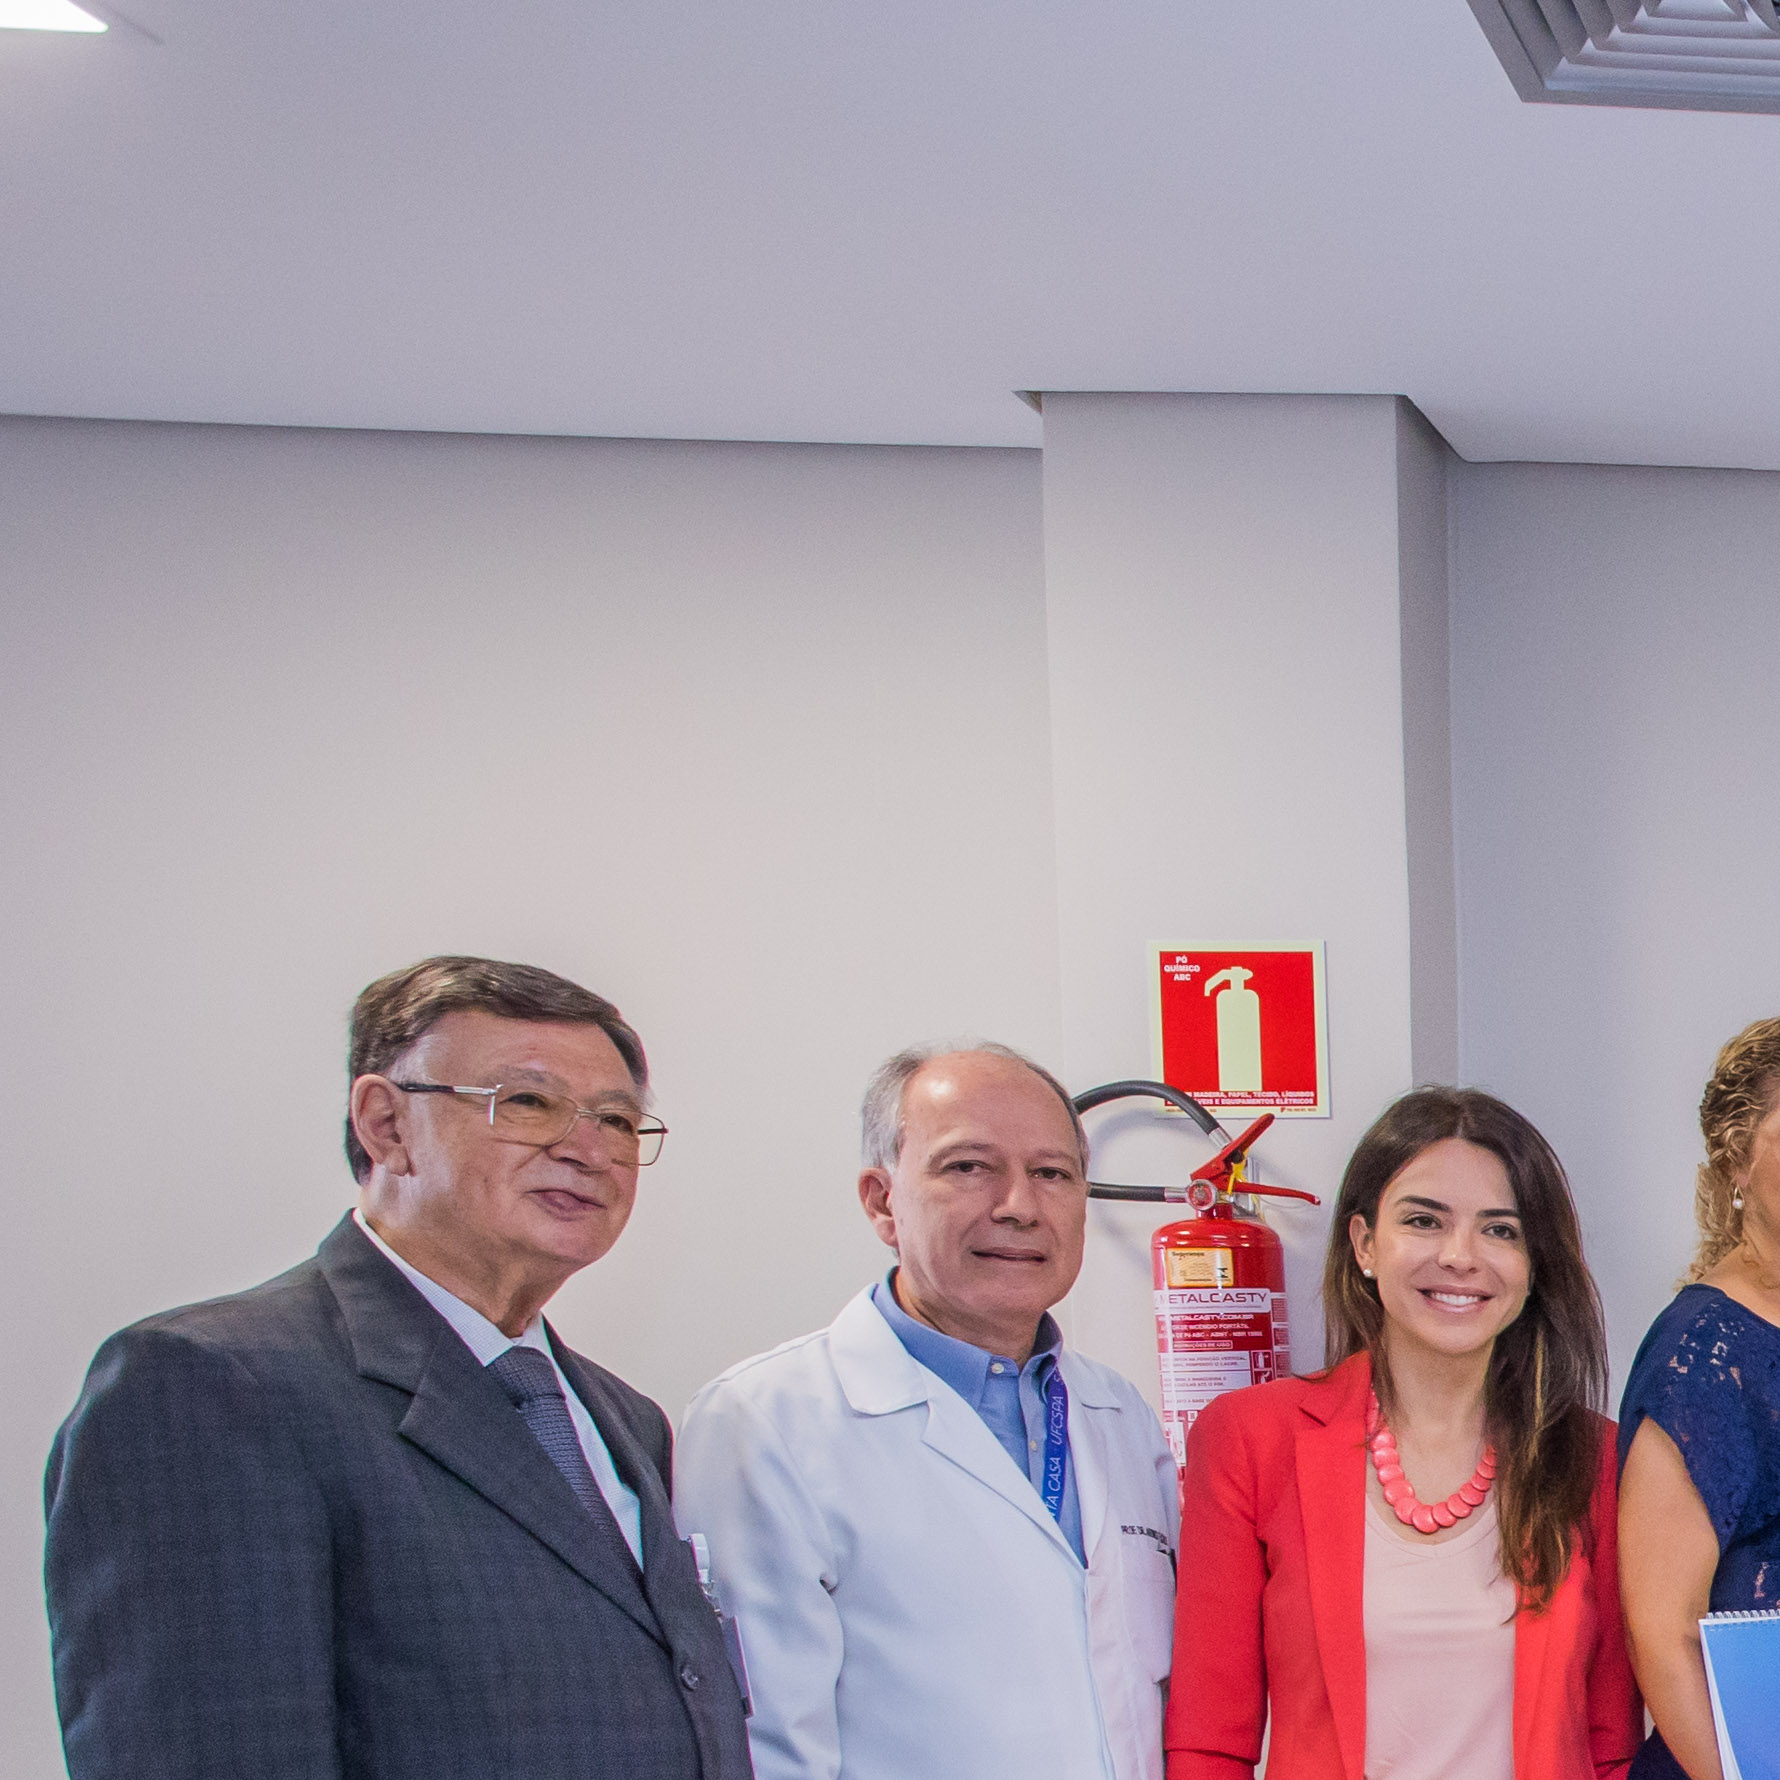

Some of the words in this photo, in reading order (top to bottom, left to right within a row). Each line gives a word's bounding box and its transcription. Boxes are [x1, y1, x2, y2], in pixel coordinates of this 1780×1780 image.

[1164, 964, 1200, 972] QUÍMICO
[1176, 955, 1188, 964] PÓ
[1051, 1396, 1064, 1445] UFCSPA
[1048, 1457, 1061, 1492] CASA
